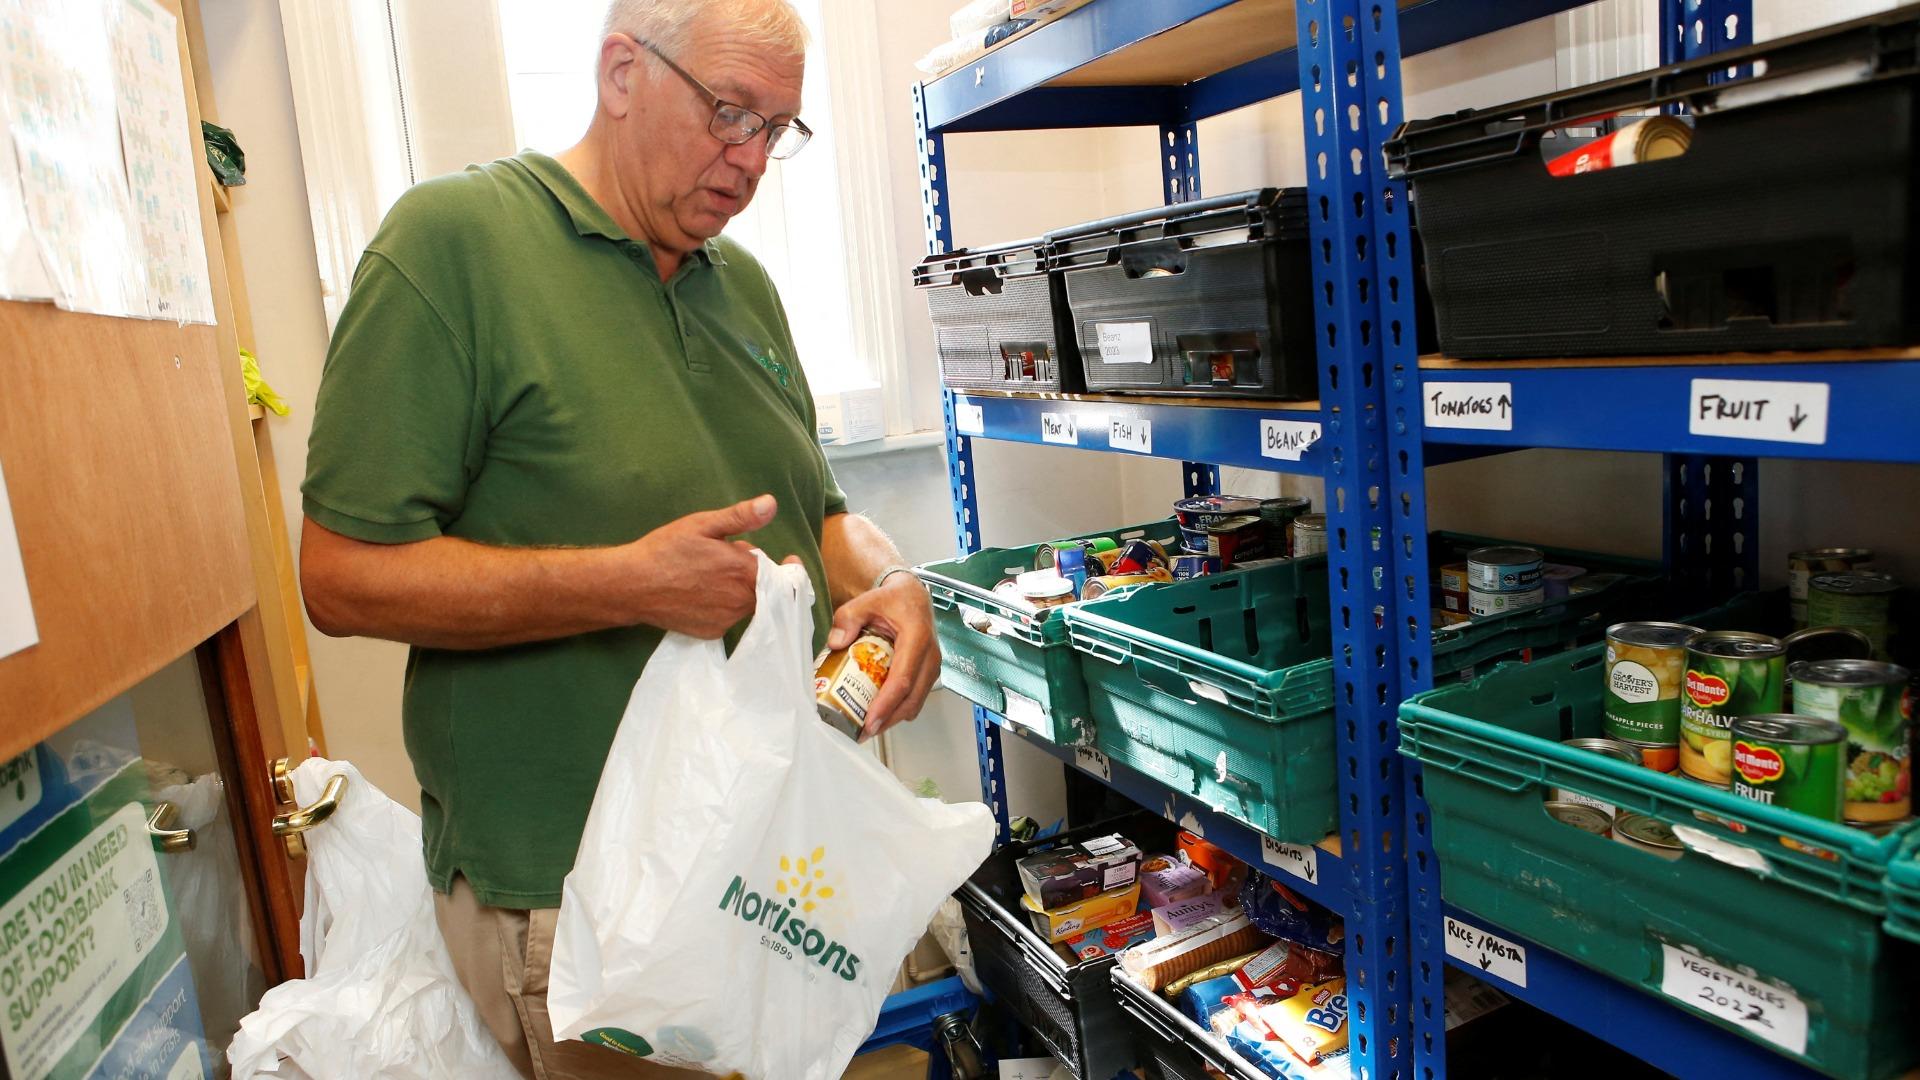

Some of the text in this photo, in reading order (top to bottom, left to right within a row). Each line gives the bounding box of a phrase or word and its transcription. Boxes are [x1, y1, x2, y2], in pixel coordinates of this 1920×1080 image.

[1431, 391, 1493, 416] TOMATOES
[1700, 395, 1770, 420] FRUIT
[842, 675, 872, 705] HICKEN
[1613, 681, 1652, 695] HARVEST
[1696, 681, 1727, 697] Monte
[1636, 721, 1664, 730] PIECES
[1695, 711, 1738, 729] HALV
[1744, 754, 1780, 771] Monte
[1734, 781, 1775, 805] FRUIT
[28, 874, 68, 924] YOU
[68, 857, 89, 892] IN
[87, 823, 129, 875] NEED
[1167, 901, 1215, 920] Aunty's
[1, 865, 119, 998] OF FOODBANK
[718, 875, 860, 981] Morrisons
[770, 940, 793, 960] 1899
[8, 925, 96, 1033] SUPPORT?
[1680, 956, 1787, 1010] VEGETABLES
[152, 986, 187, 1035] support
